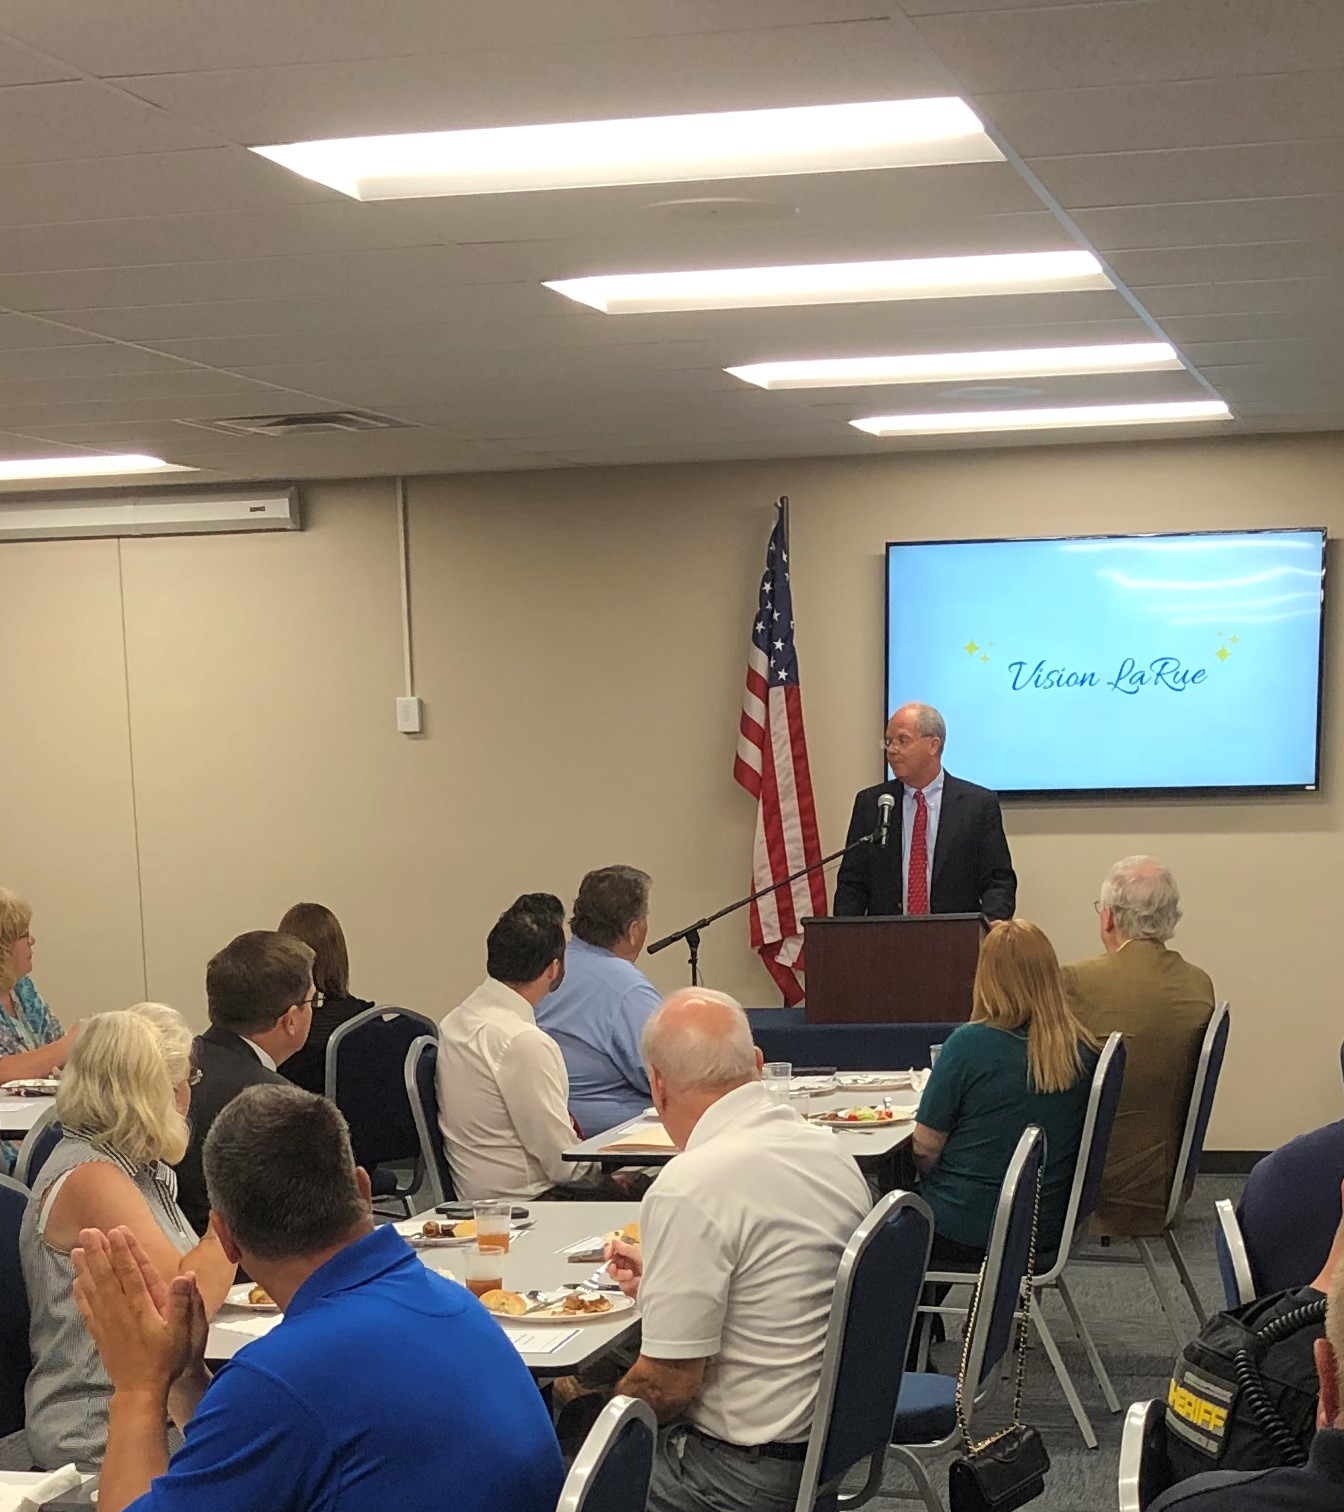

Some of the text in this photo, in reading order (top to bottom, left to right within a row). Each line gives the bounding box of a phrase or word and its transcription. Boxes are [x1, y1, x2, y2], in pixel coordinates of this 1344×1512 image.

[1008, 657, 1208, 695] Vision LaRue
[1168, 1377, 1228, 1431] HERIFF
